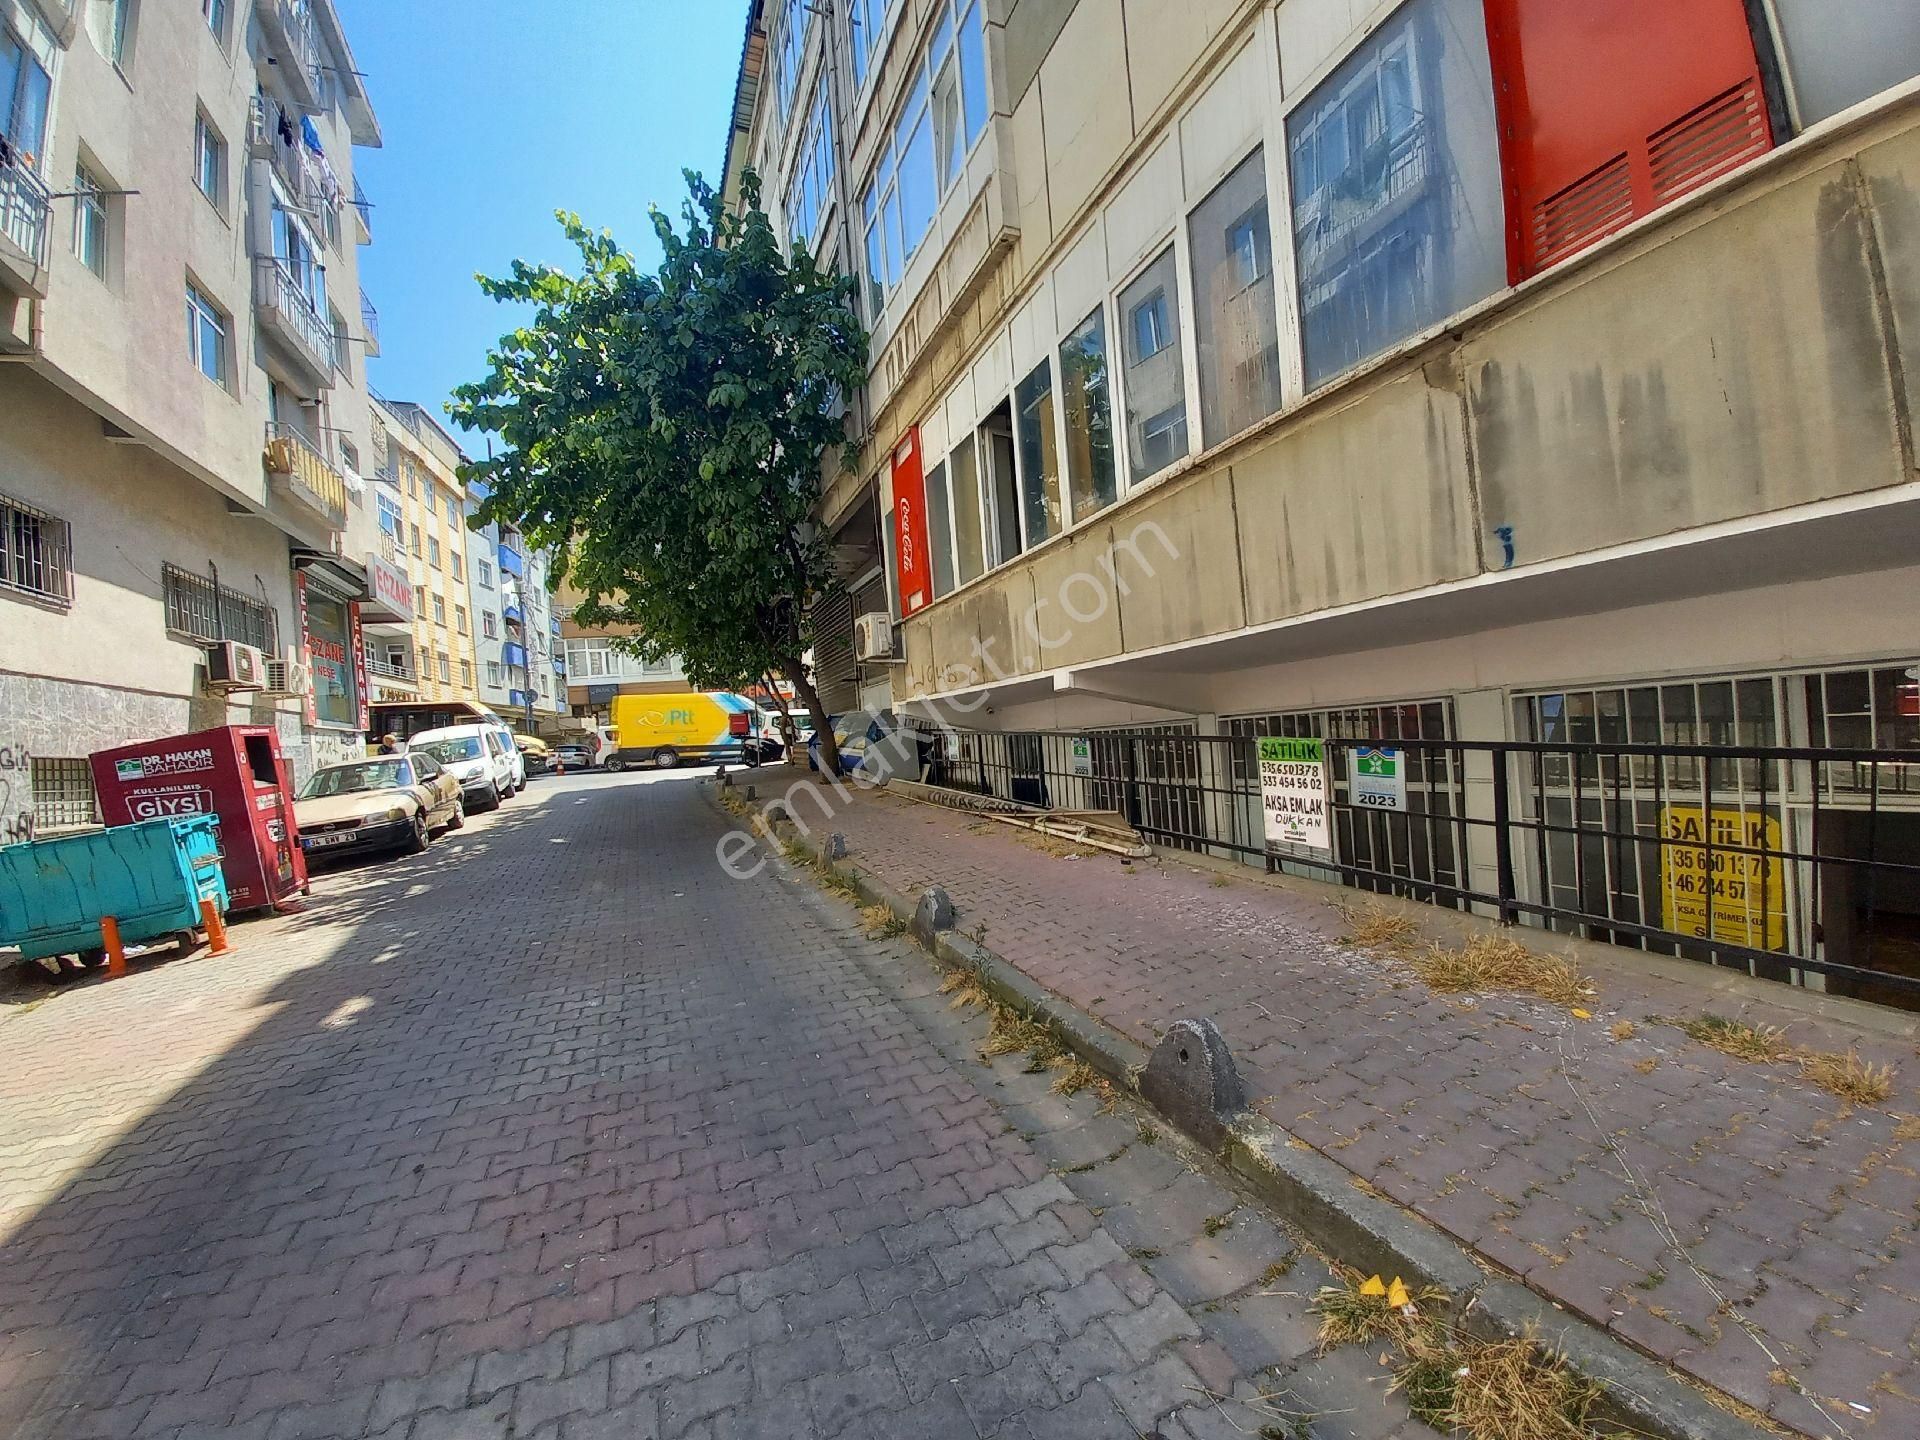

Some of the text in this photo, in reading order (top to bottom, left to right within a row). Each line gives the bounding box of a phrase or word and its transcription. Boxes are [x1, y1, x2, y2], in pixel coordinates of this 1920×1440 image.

[900, 497, 914, 574] Coca-Cola
[375, 564, 413, 611] ECZANE
[308, 635, 345, 665] CZANE
[353, 615, 369, 718] ECZANE
[165, 749, 211, 762] HAKAN
[1261, 742, 1318, 760] SATILIK
[1263, 775, 1322, 790] 533 454 56 02
[137, 793, 202, 817] GİYSİ
[1265, 795, 1323, 816] AKSA EMLAK
[1358, 793, 1397, 807] 2023
[1671, 904, 1696, 916] KSA
